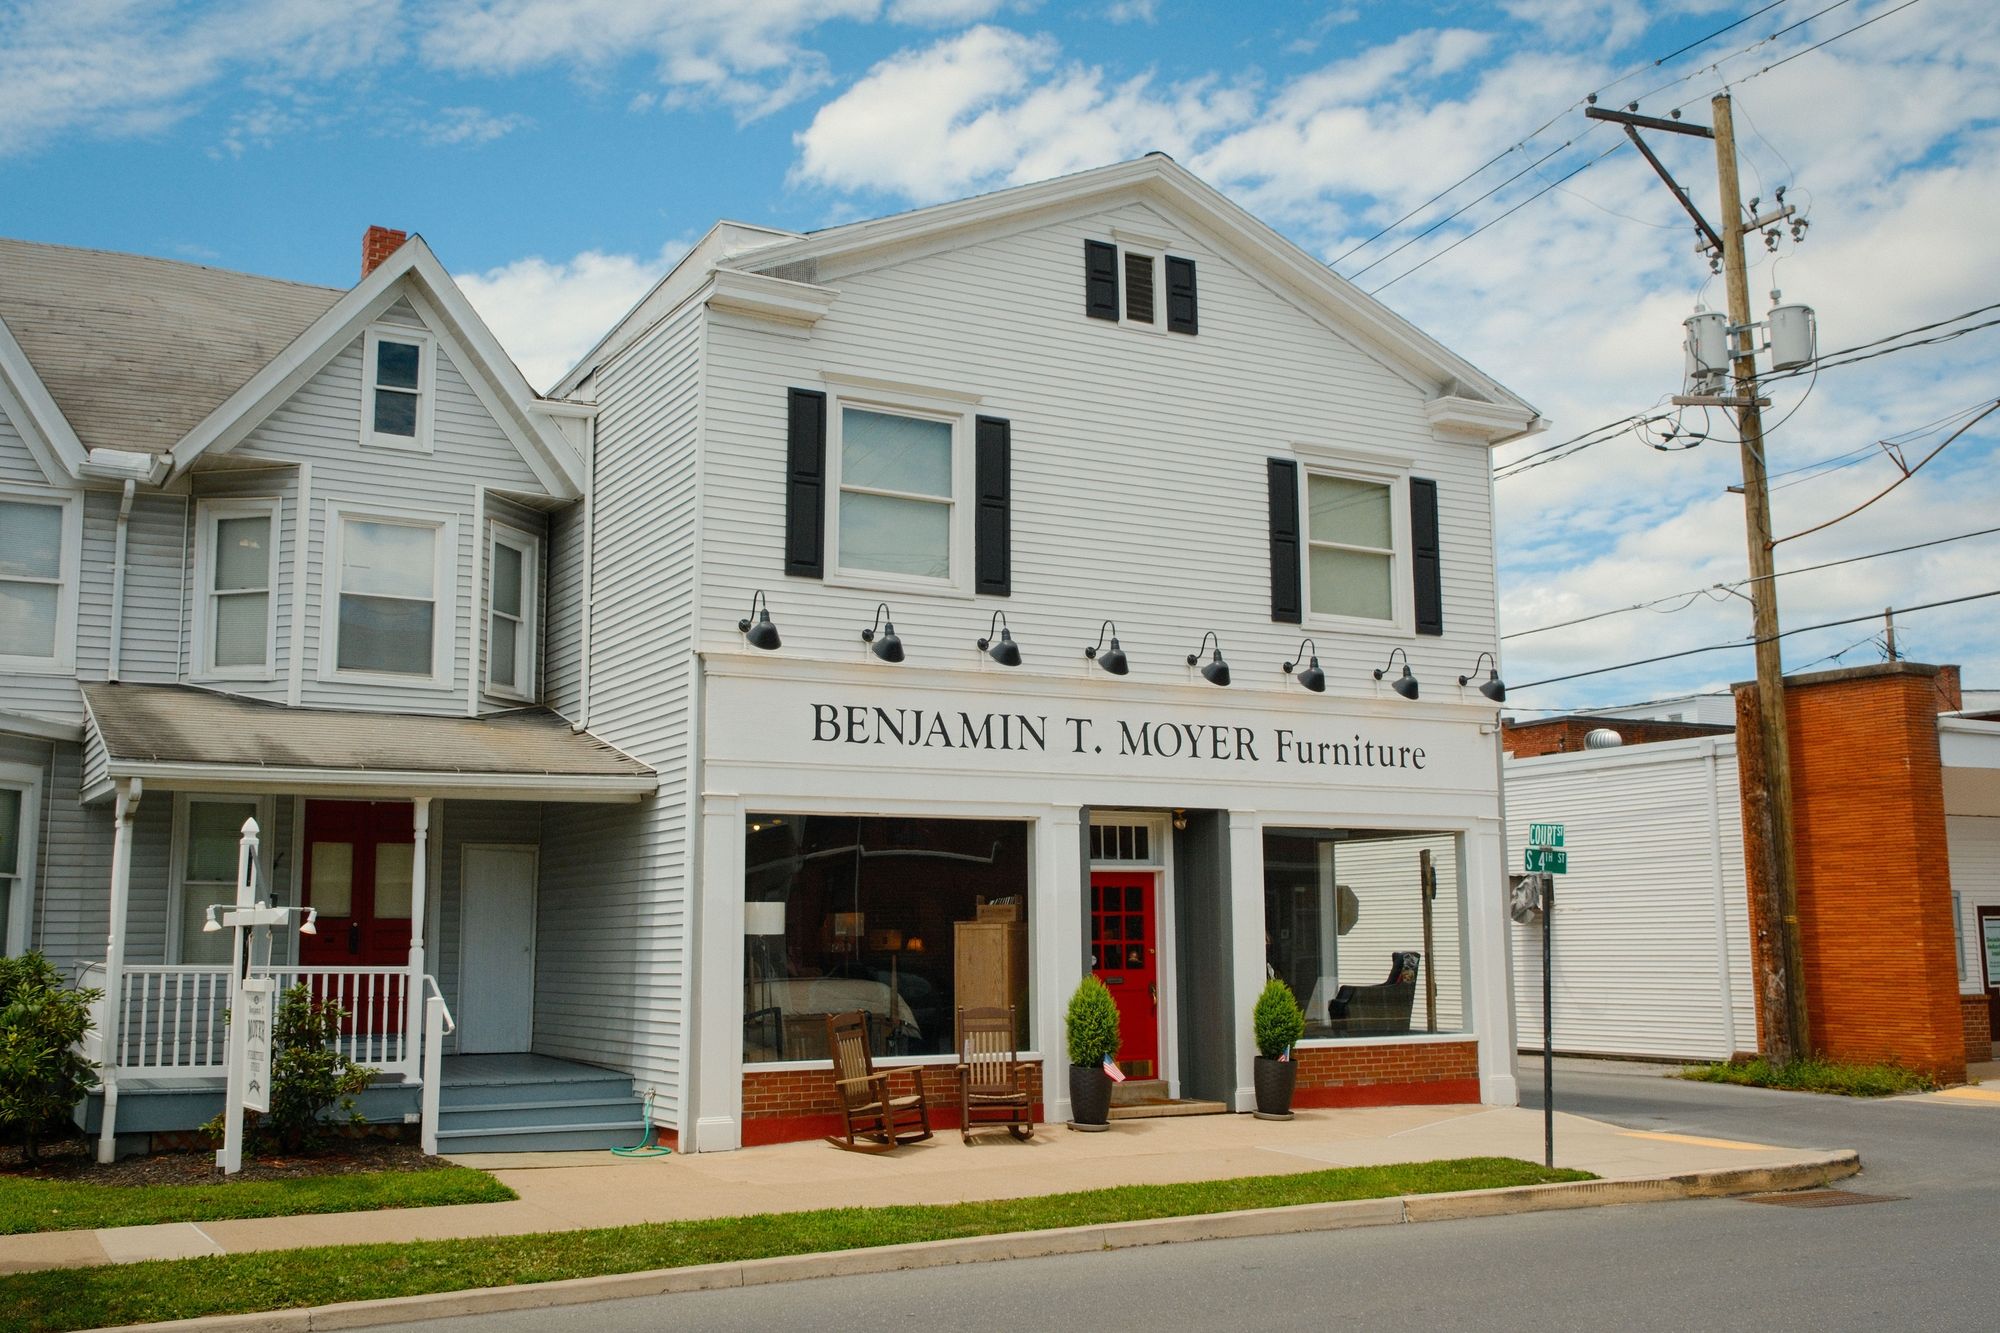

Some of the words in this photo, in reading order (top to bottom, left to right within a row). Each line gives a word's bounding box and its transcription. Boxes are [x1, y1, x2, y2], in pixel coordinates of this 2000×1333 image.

[810, 703, 1048, 751] BENJAMIN
[1065, 717, 1102, 754] T.
[1116, 720, 1260, 761] MOYER
[1274, 728, 1426, 769] Furniture
[1530, 825, 1557, 845] COURT
[1557, 826, 1563, 836] ST
[1526, 850, 1532, 870] S
[1538, 852, 1553, 871] 4TH
[1557, 853, 1565, 863] ST
